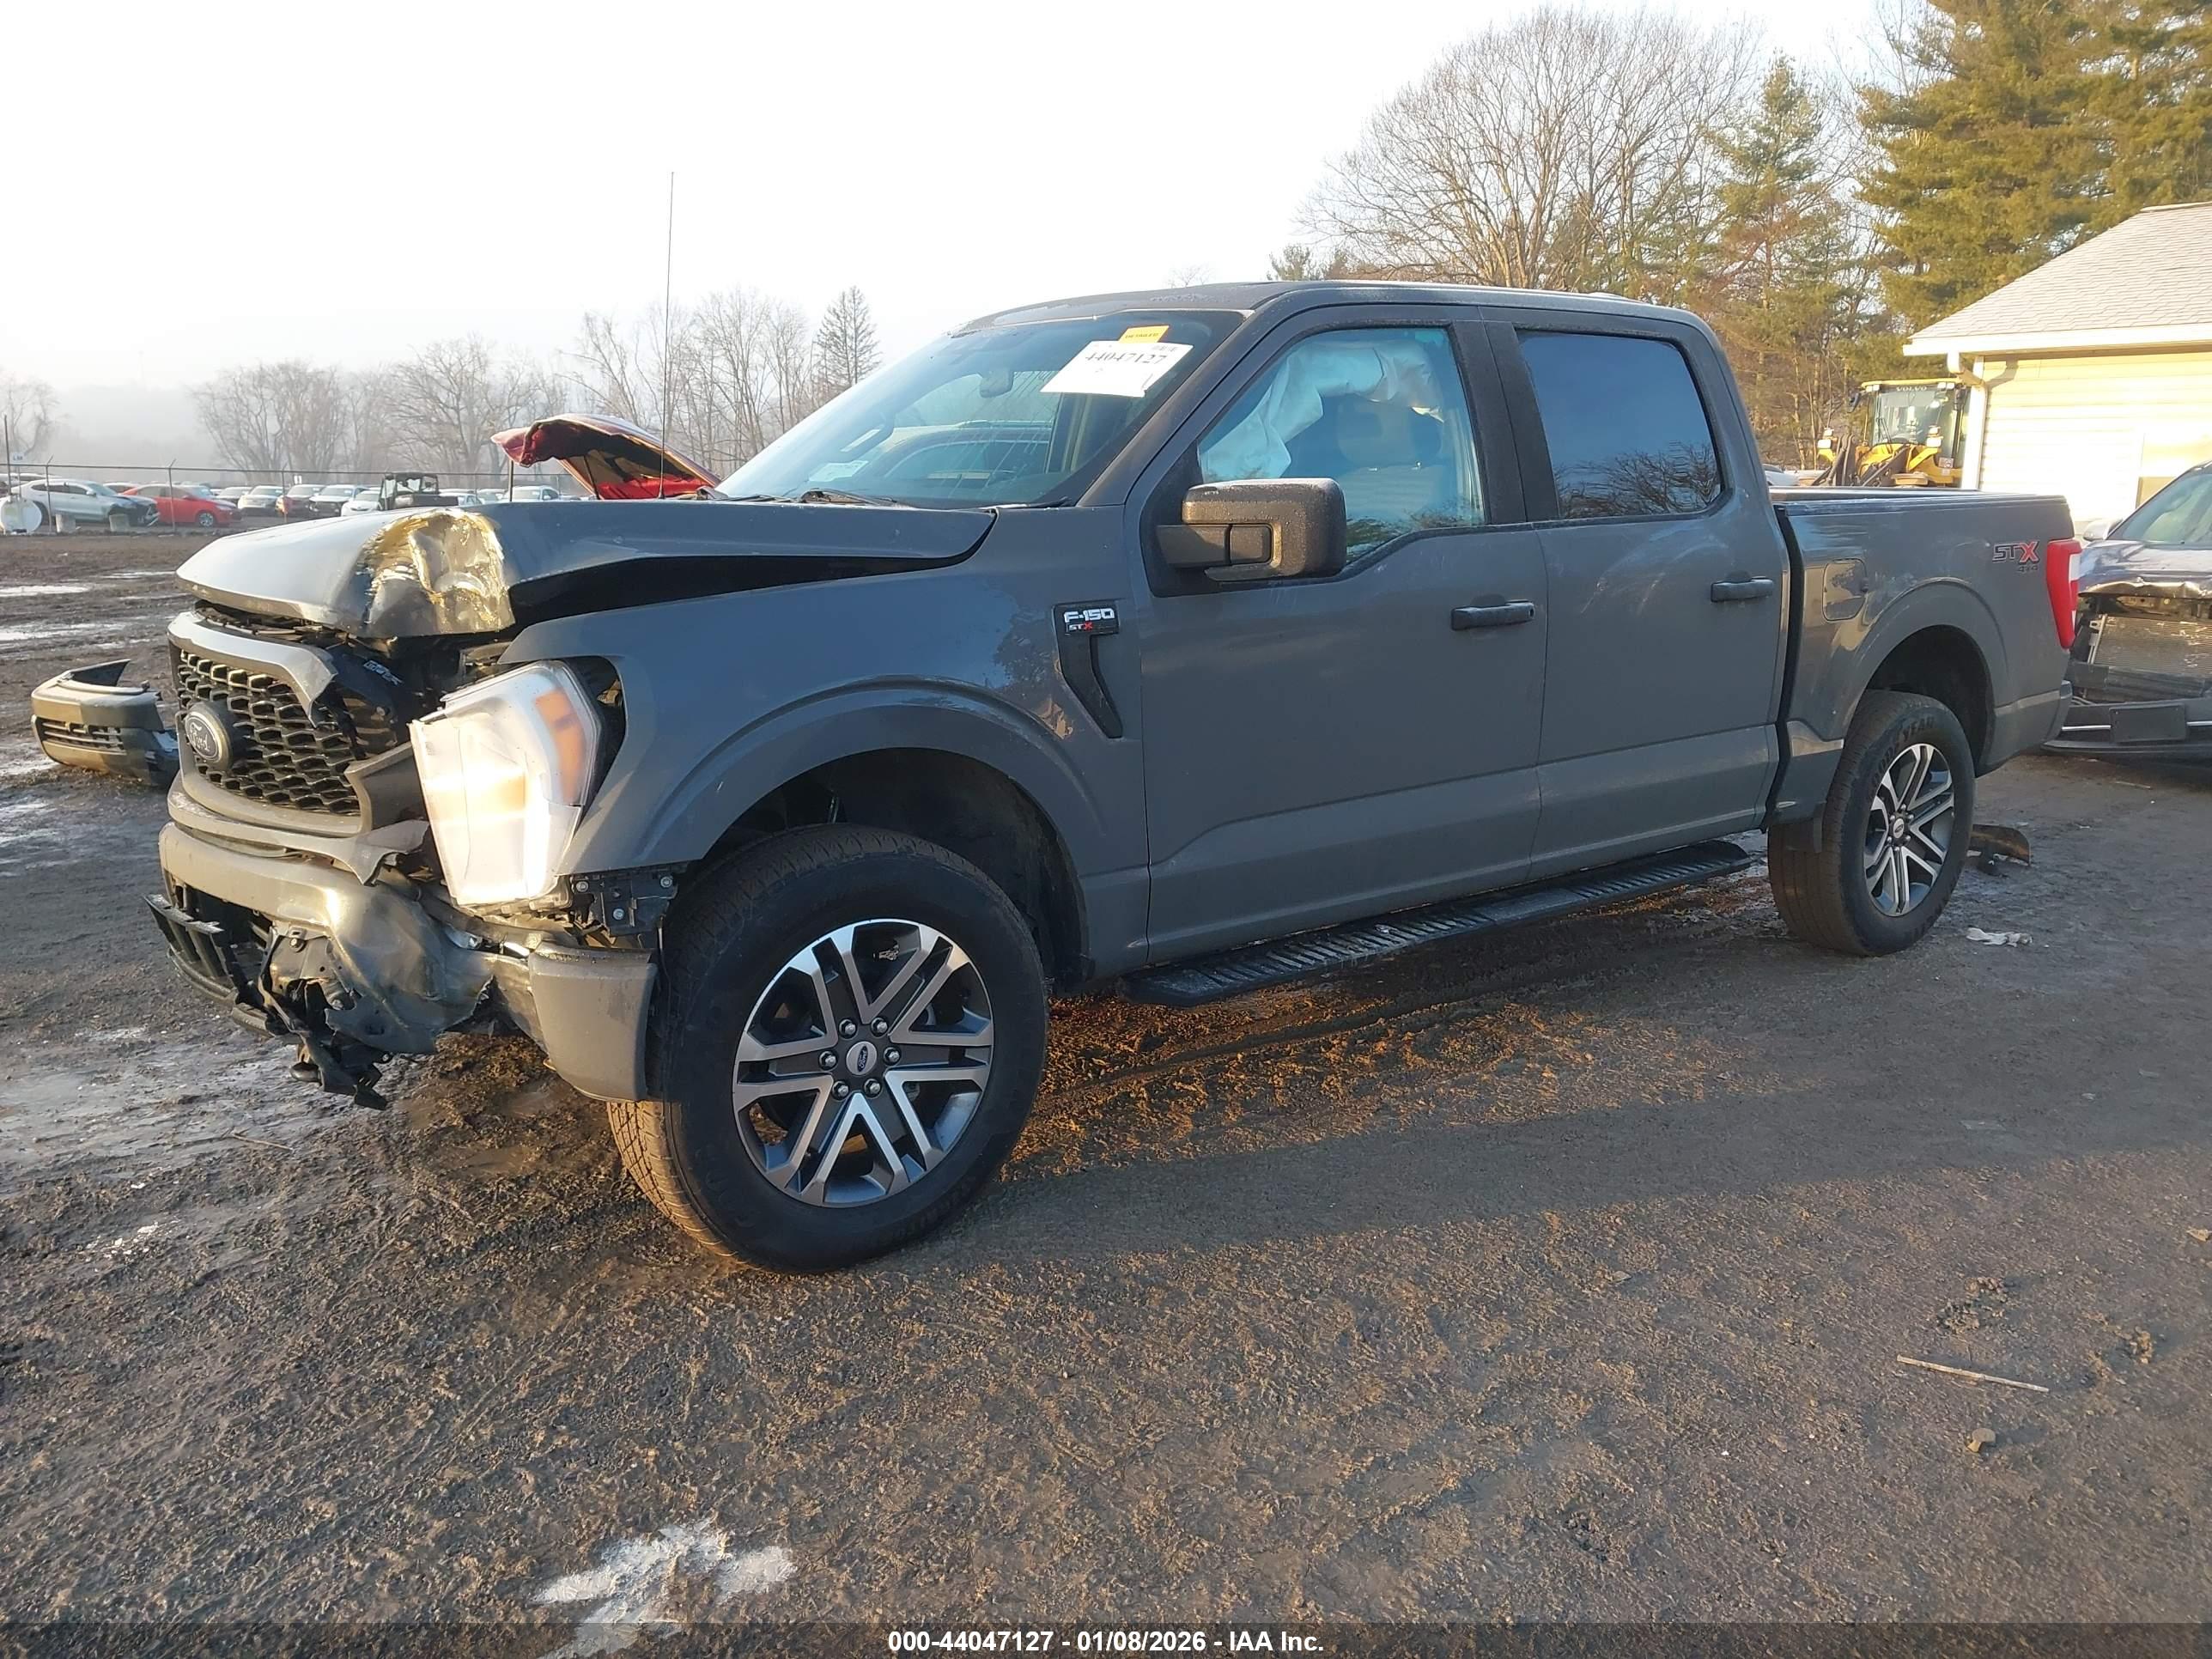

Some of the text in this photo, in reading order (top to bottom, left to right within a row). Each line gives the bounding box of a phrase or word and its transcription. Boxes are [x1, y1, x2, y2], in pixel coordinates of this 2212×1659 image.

[1085, 351, 1168, 364] 44047127
[1992, 540, 2040, 563] STX
[1063, 608, 1115, 623] F-150
[1068, 622, 1093, 631] STX
